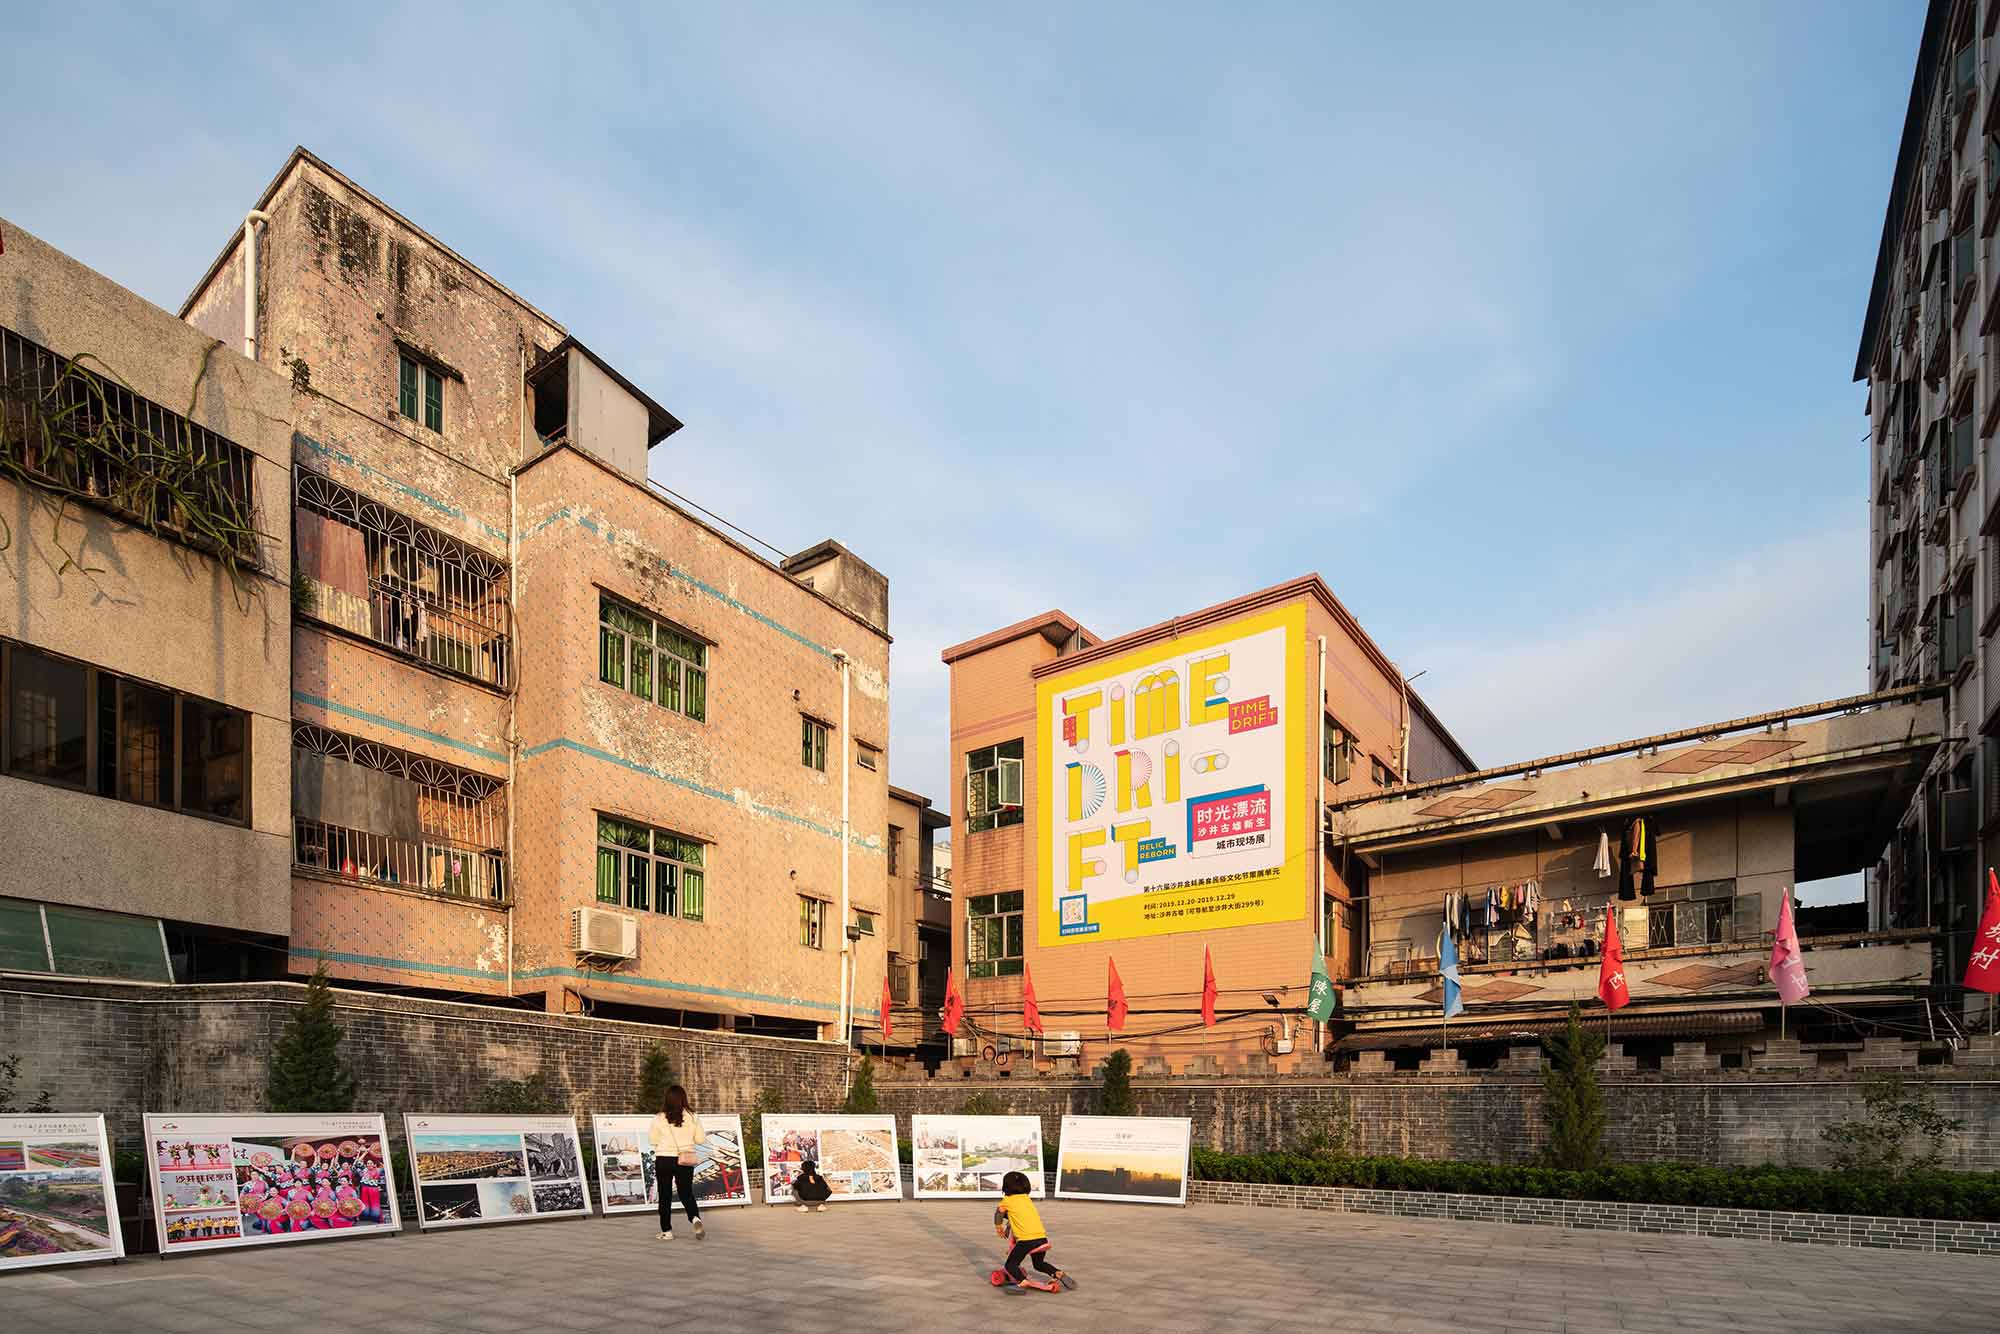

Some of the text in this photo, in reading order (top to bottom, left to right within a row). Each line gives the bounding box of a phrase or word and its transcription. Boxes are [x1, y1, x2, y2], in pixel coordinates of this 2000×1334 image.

[1232, 700, 1267, 718] TIME
[1232, 710, 1277, 730] DRIFT
[1197, 798, 1267, 824] 时光漂流
[1140, 841, 1164, 851] RELIC
[1216, 833, 1265, 850] 城市现场展
[1140, 848, 1175, 859] REBORN
